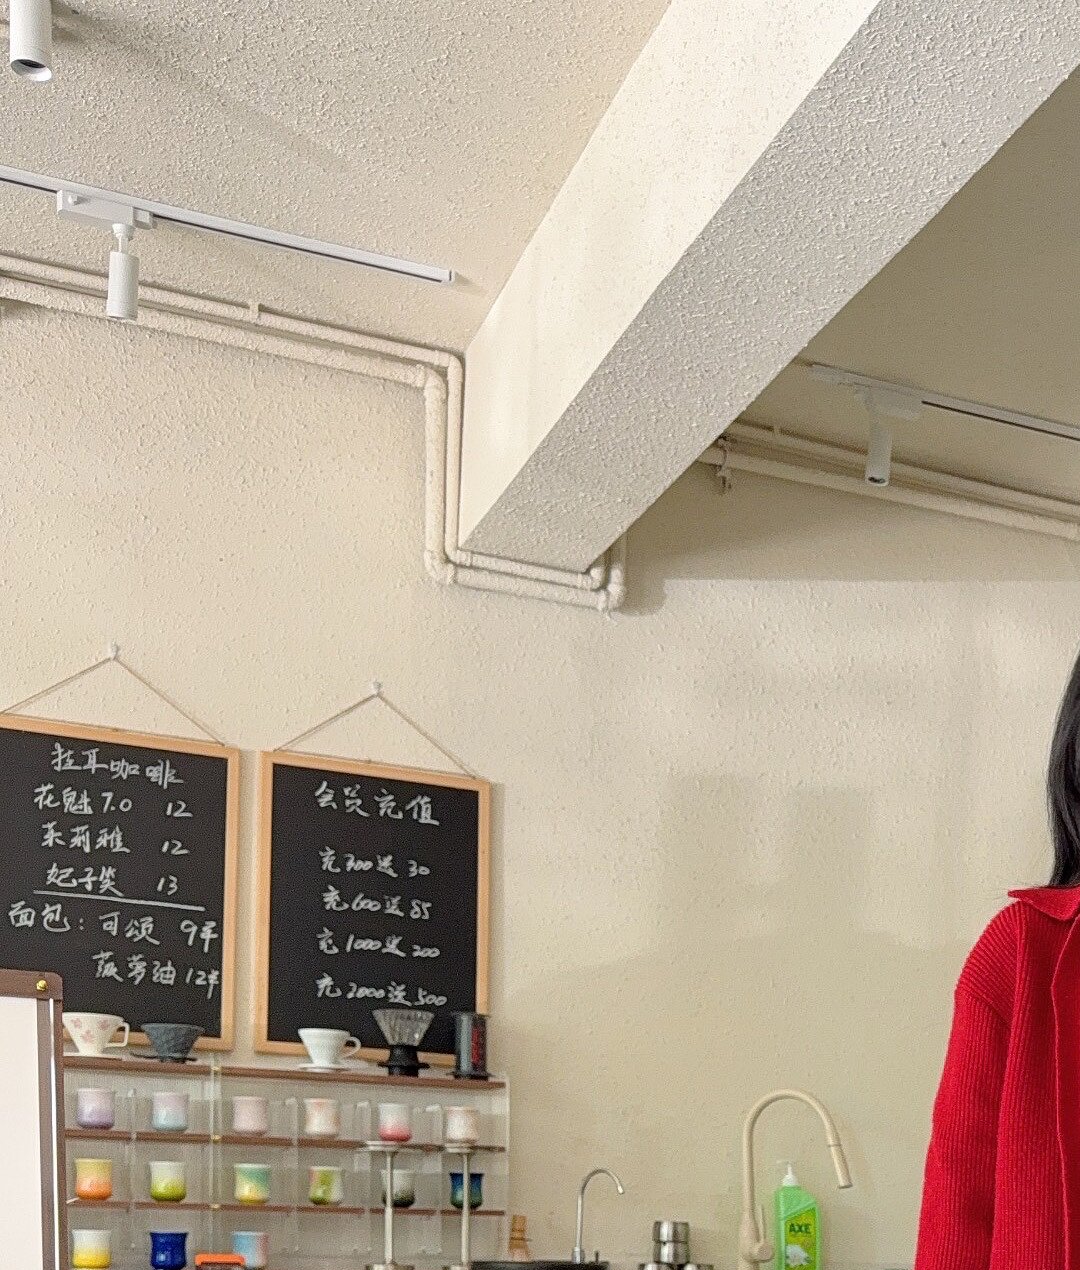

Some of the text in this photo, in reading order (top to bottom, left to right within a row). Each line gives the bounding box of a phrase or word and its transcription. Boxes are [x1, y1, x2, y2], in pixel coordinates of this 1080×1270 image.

[51, 742, 184, 788] 挂耳咖啡
[166, 801, 192, 817] 12
[315, 781, 439, 826] 会员充值
[162, 841, 188, 854] 12
[46, 863, 177, 897] 妃子笑 13
[93, 951, 176, 985] 菠萝油
[789, 1223, 812, 1234] AXE
